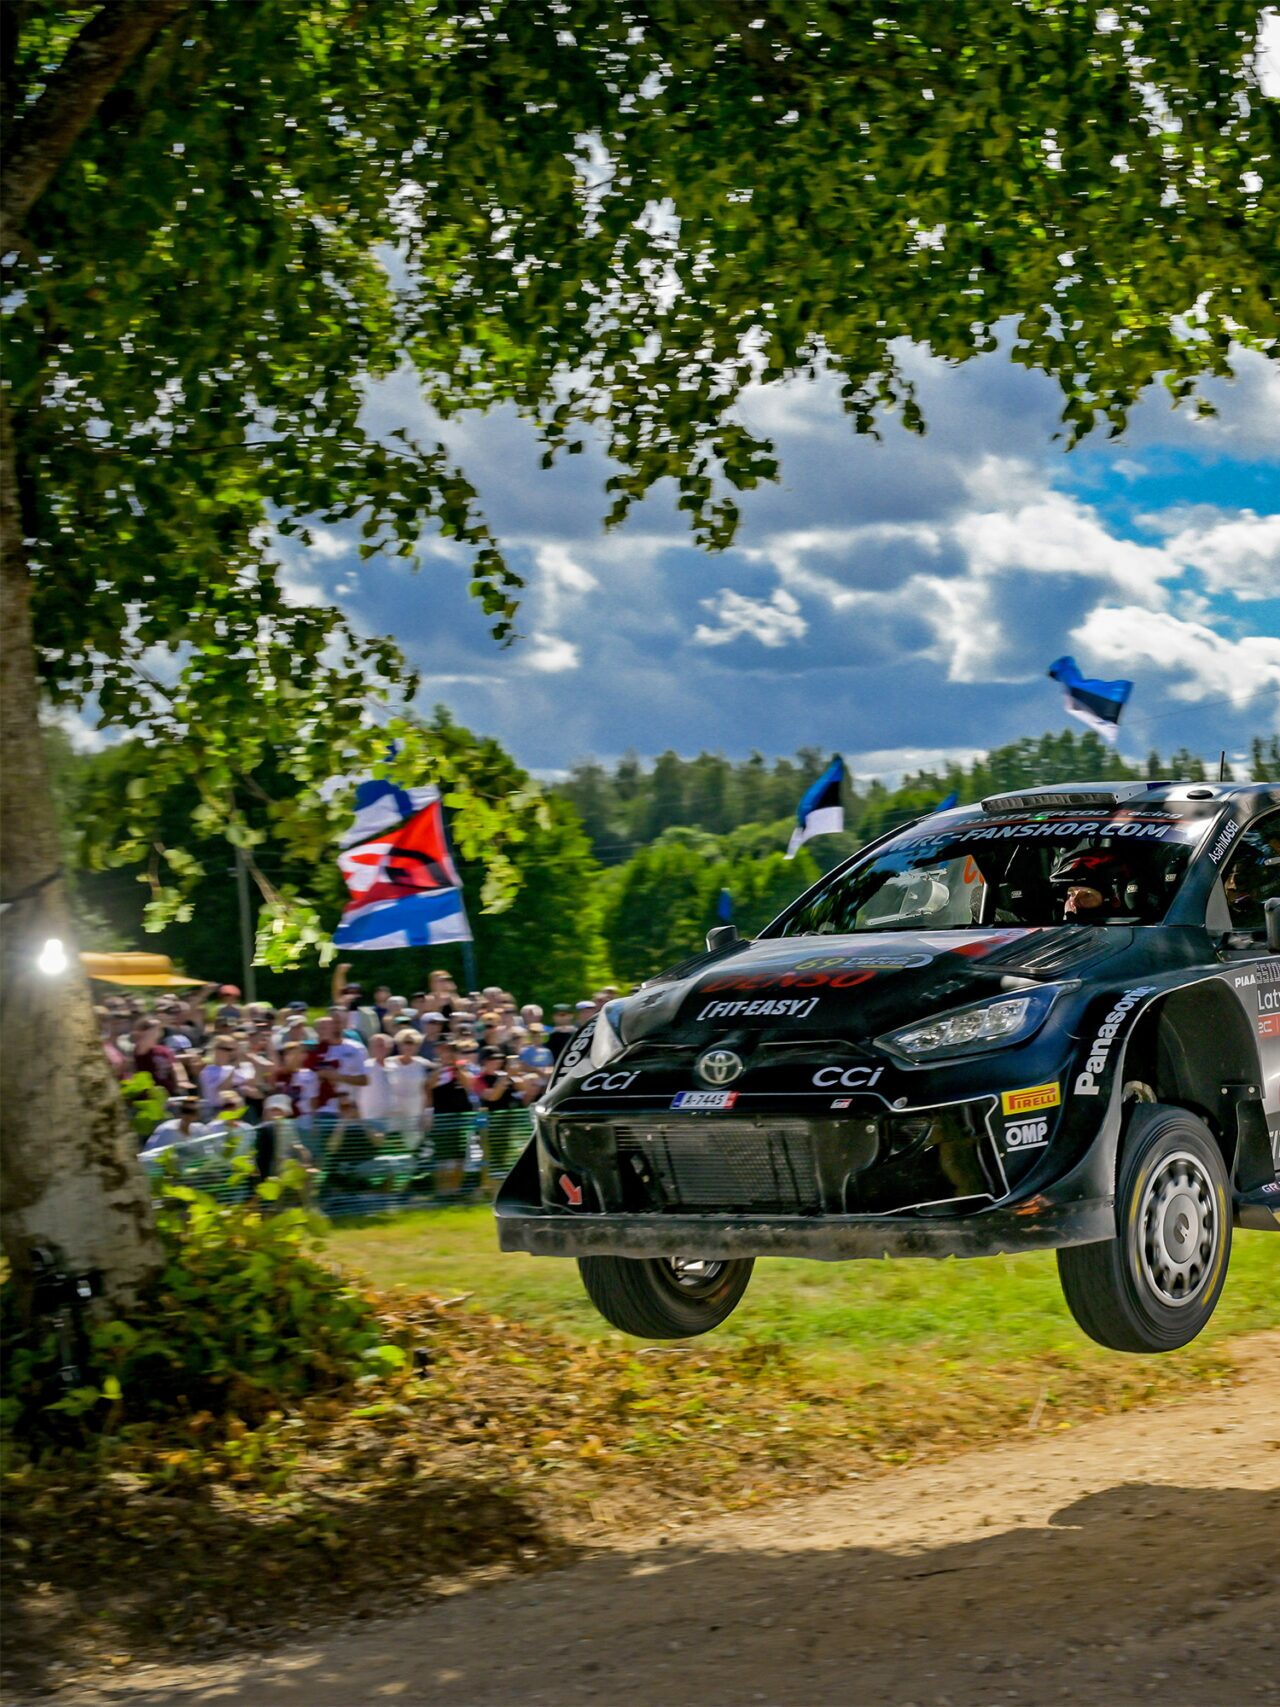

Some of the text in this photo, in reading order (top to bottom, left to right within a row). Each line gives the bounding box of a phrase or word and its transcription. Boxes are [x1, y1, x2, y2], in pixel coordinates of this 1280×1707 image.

[889, 822, 1171, 852] WRC-FANSHOP.COM
[1208, 819, 1239, 864] AsahiKASEI
[795, 957, 845, 970] 69
[700, 970, 878, 993] DENSO
[1234, 974, 1256, 988] PIAA
[1074, 986, 1156, 1095] Panasonic
[1009, 1088, 1055, 1110] PIRELLI
[1006, 1122, 1048, 1146] OMP
